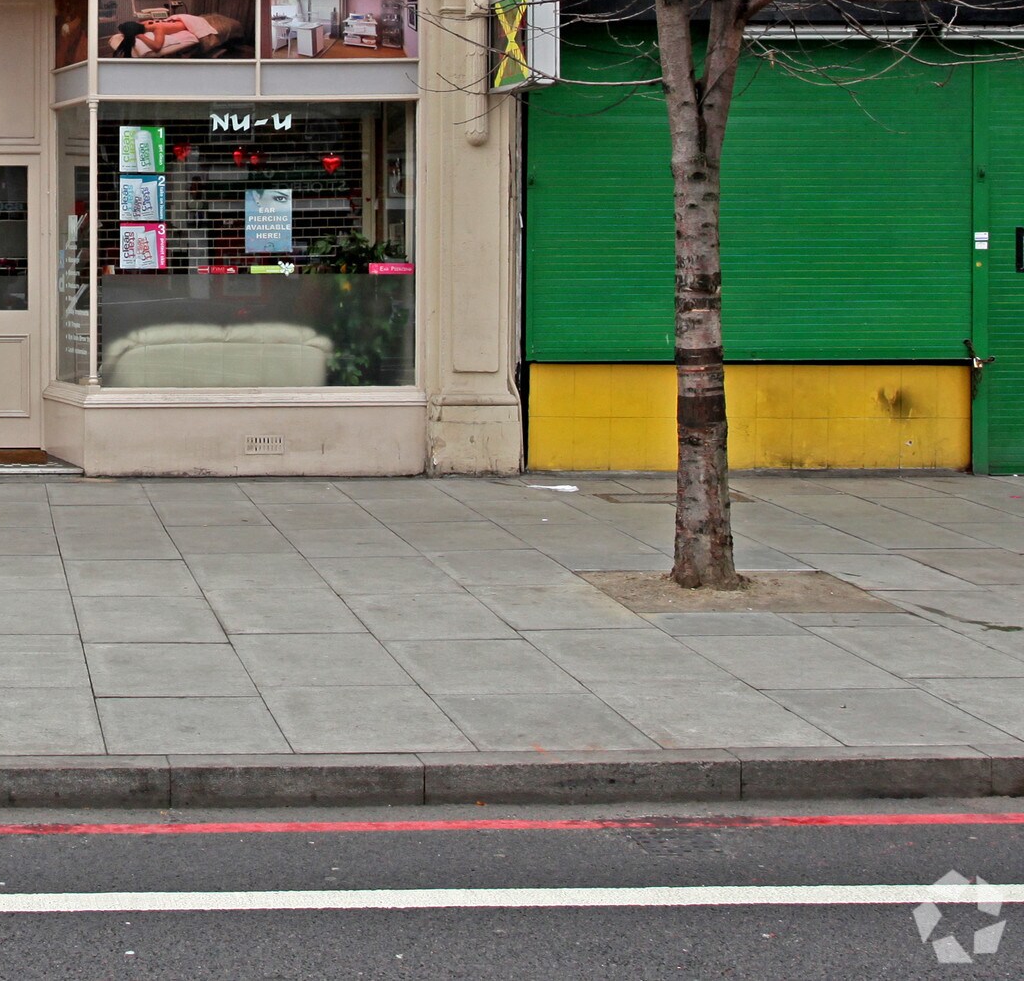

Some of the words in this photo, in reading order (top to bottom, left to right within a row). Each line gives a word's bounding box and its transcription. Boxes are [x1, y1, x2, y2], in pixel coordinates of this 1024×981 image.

[157, 128, 163, 138] 1
[139, 142, 147, 167] clean
[158, 176, 165, 186] 2
[121, 184, 129, 211] clean
[158, 224, 165, 235] 3
